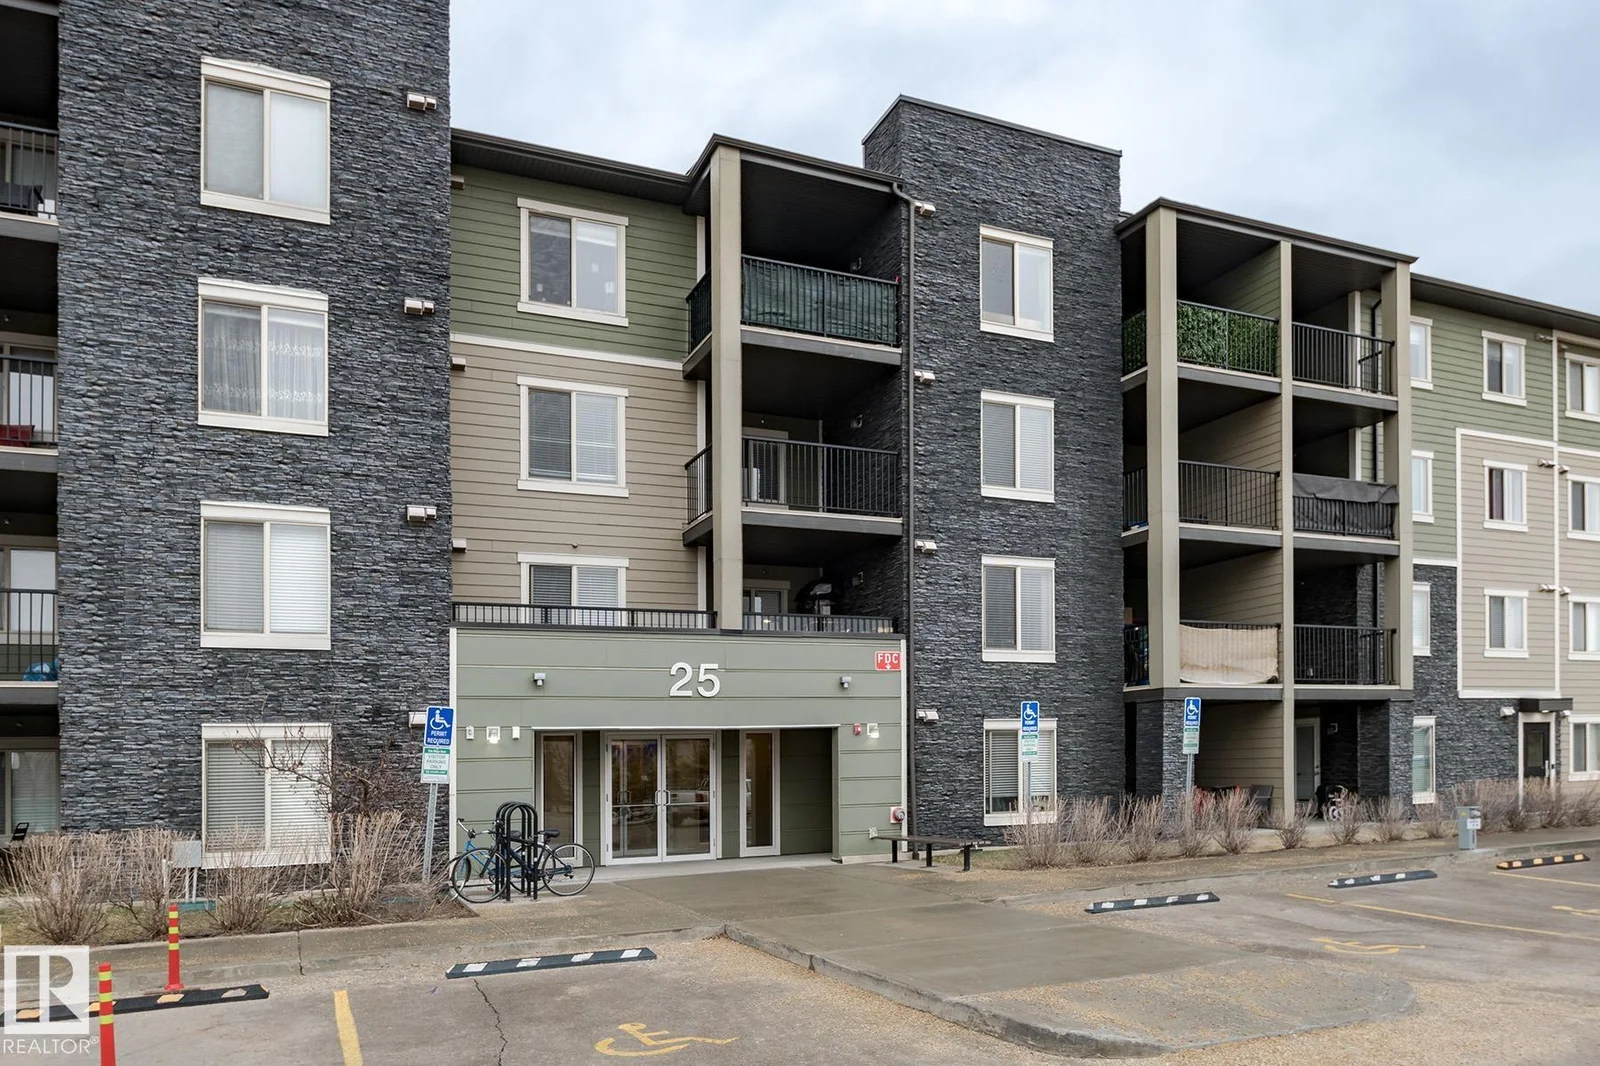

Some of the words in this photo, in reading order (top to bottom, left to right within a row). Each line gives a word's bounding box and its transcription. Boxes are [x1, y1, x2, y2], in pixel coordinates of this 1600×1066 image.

[877, 653, 899, 664] FDC
[669, 661, 721, 698] 25
[426, 737, 450, 745] REQUIRED
